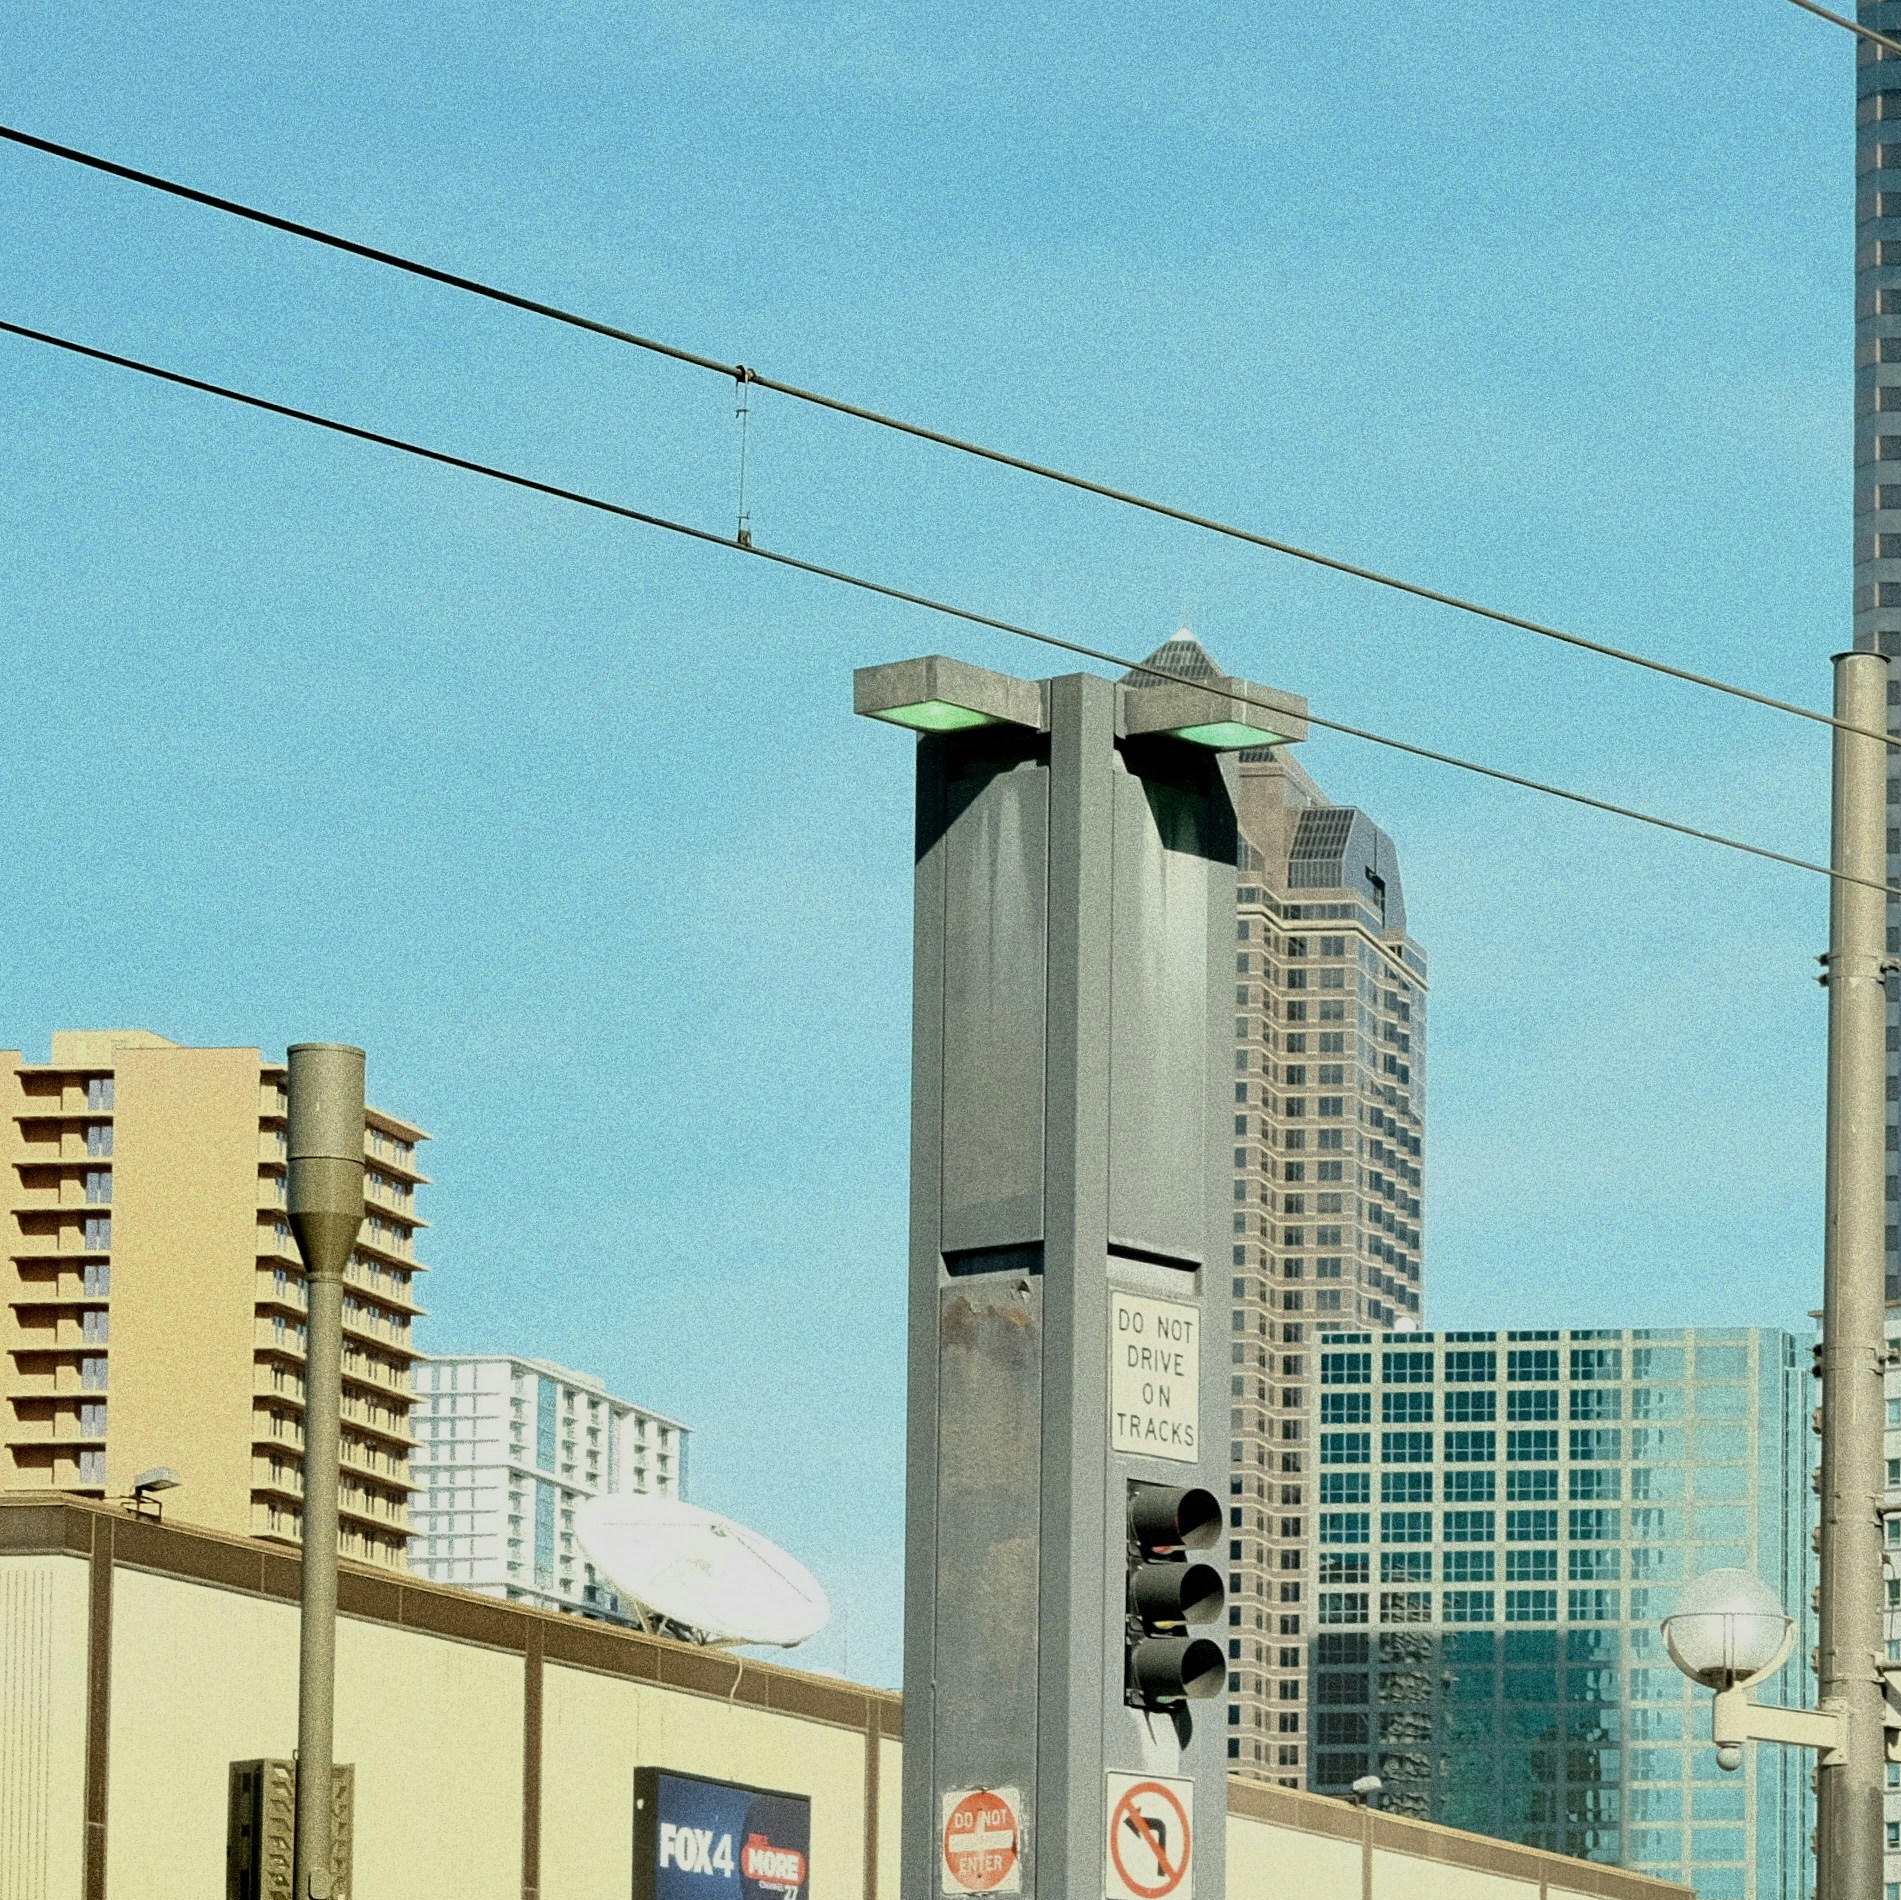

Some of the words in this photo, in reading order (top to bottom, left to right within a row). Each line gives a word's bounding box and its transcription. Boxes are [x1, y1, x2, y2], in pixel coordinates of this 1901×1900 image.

[1118, 1308, 1144, 1334] DO
[1157, 1315, 1193, 1344] NOT
[1127, 1344, 1185, 1377] DRIVE
[1142, 1382, 1171, 1408] ON
[1116, 1412, 1195, 1447] TRACKS
[953, 1812, 975, 1829] DO
[983, 1808, 1007, 1826] NOT
[748, 1847, 800, 1881] MORE
[958, 1855, 1003, 1876] ENTER
